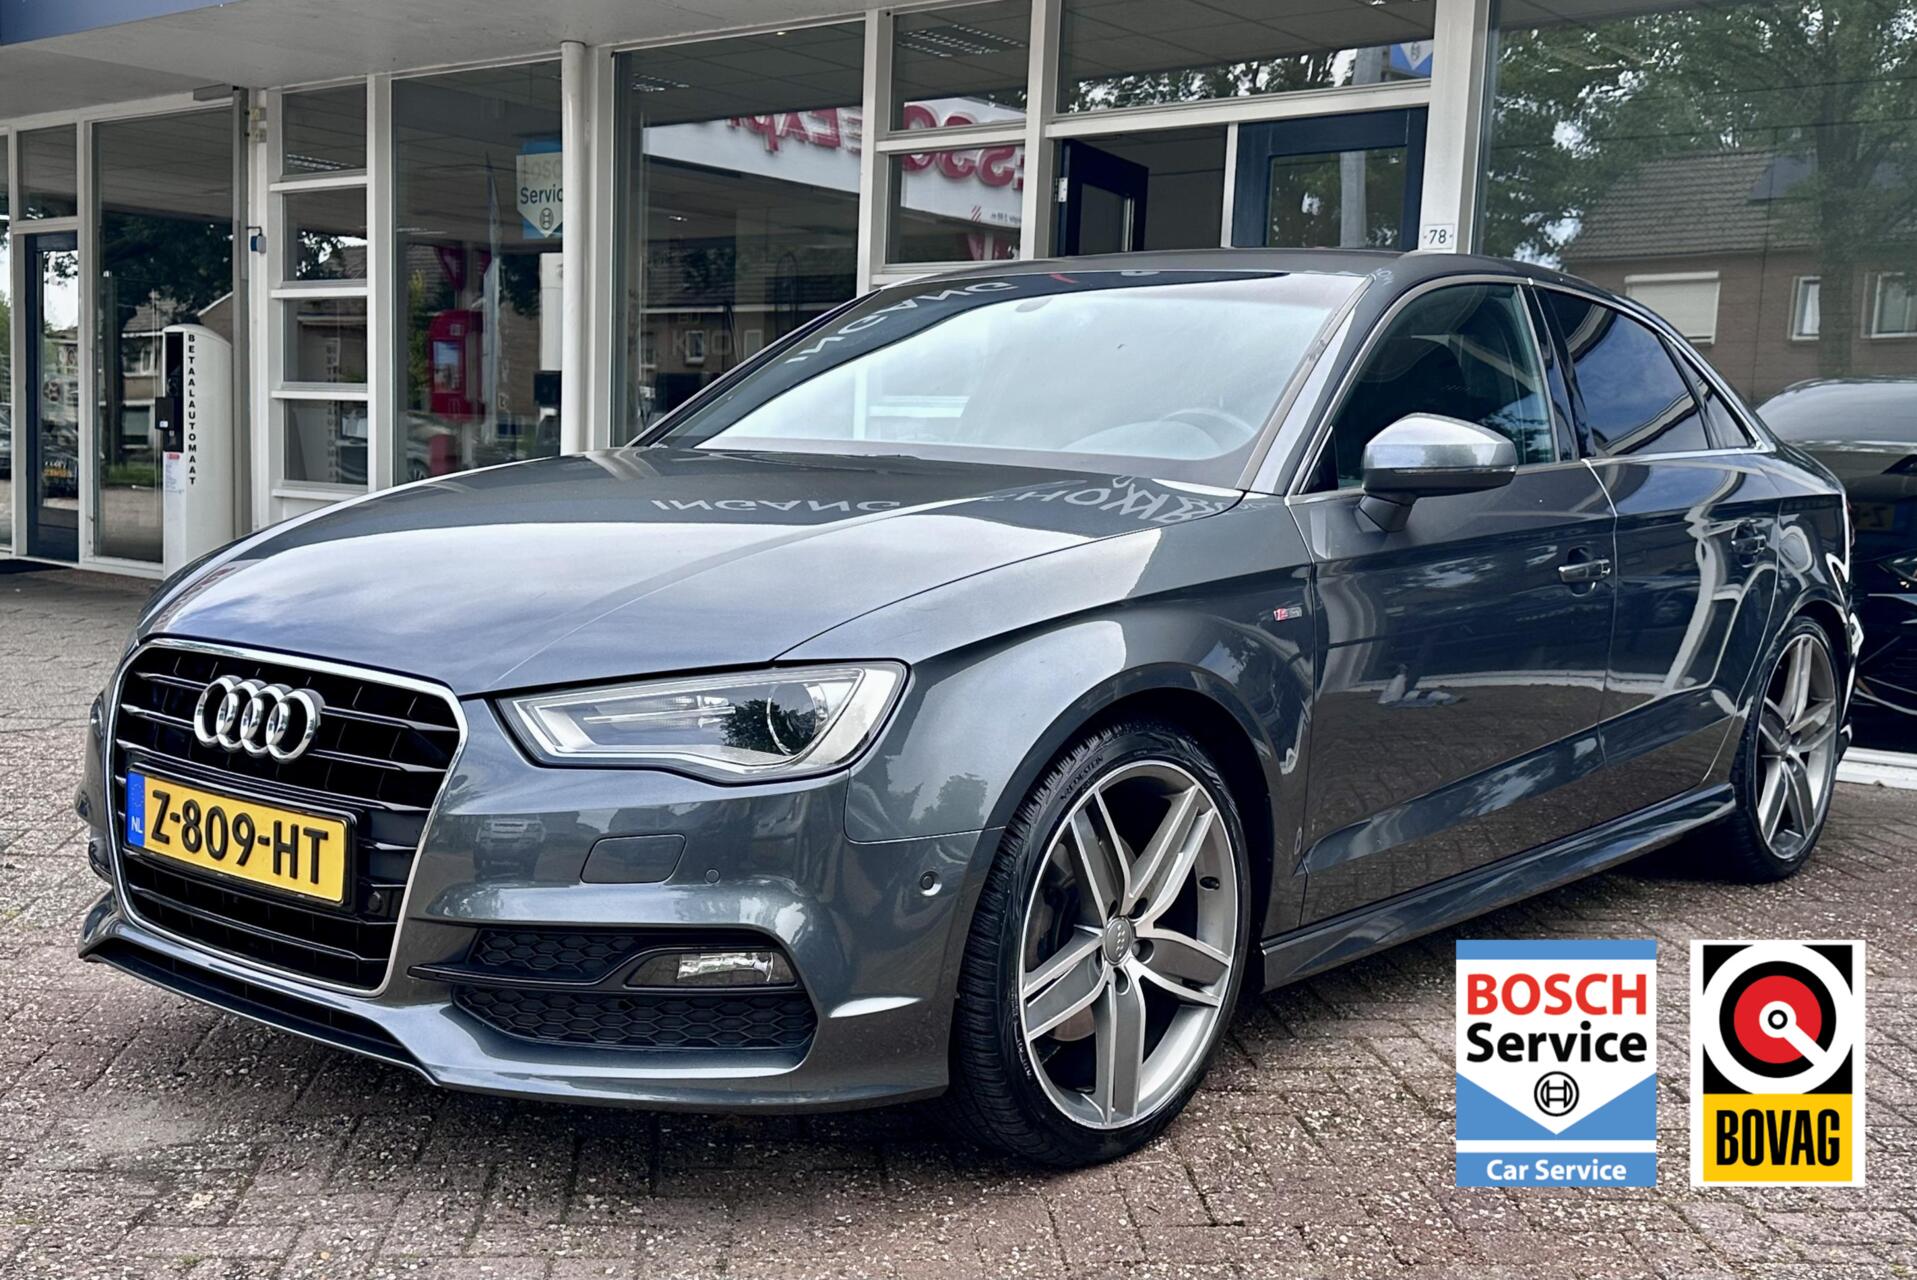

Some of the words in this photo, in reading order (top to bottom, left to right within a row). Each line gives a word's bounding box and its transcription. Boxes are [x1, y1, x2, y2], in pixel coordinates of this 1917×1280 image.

[520, 184, 563, 205] Servic
[1429, 229, 1447, 244] 78
[188, 334, 197, 485] BETAALAUTOMAAT
[130, 816, 143, 835] NL
[151, 789, 329, 886] Z-809-HT
